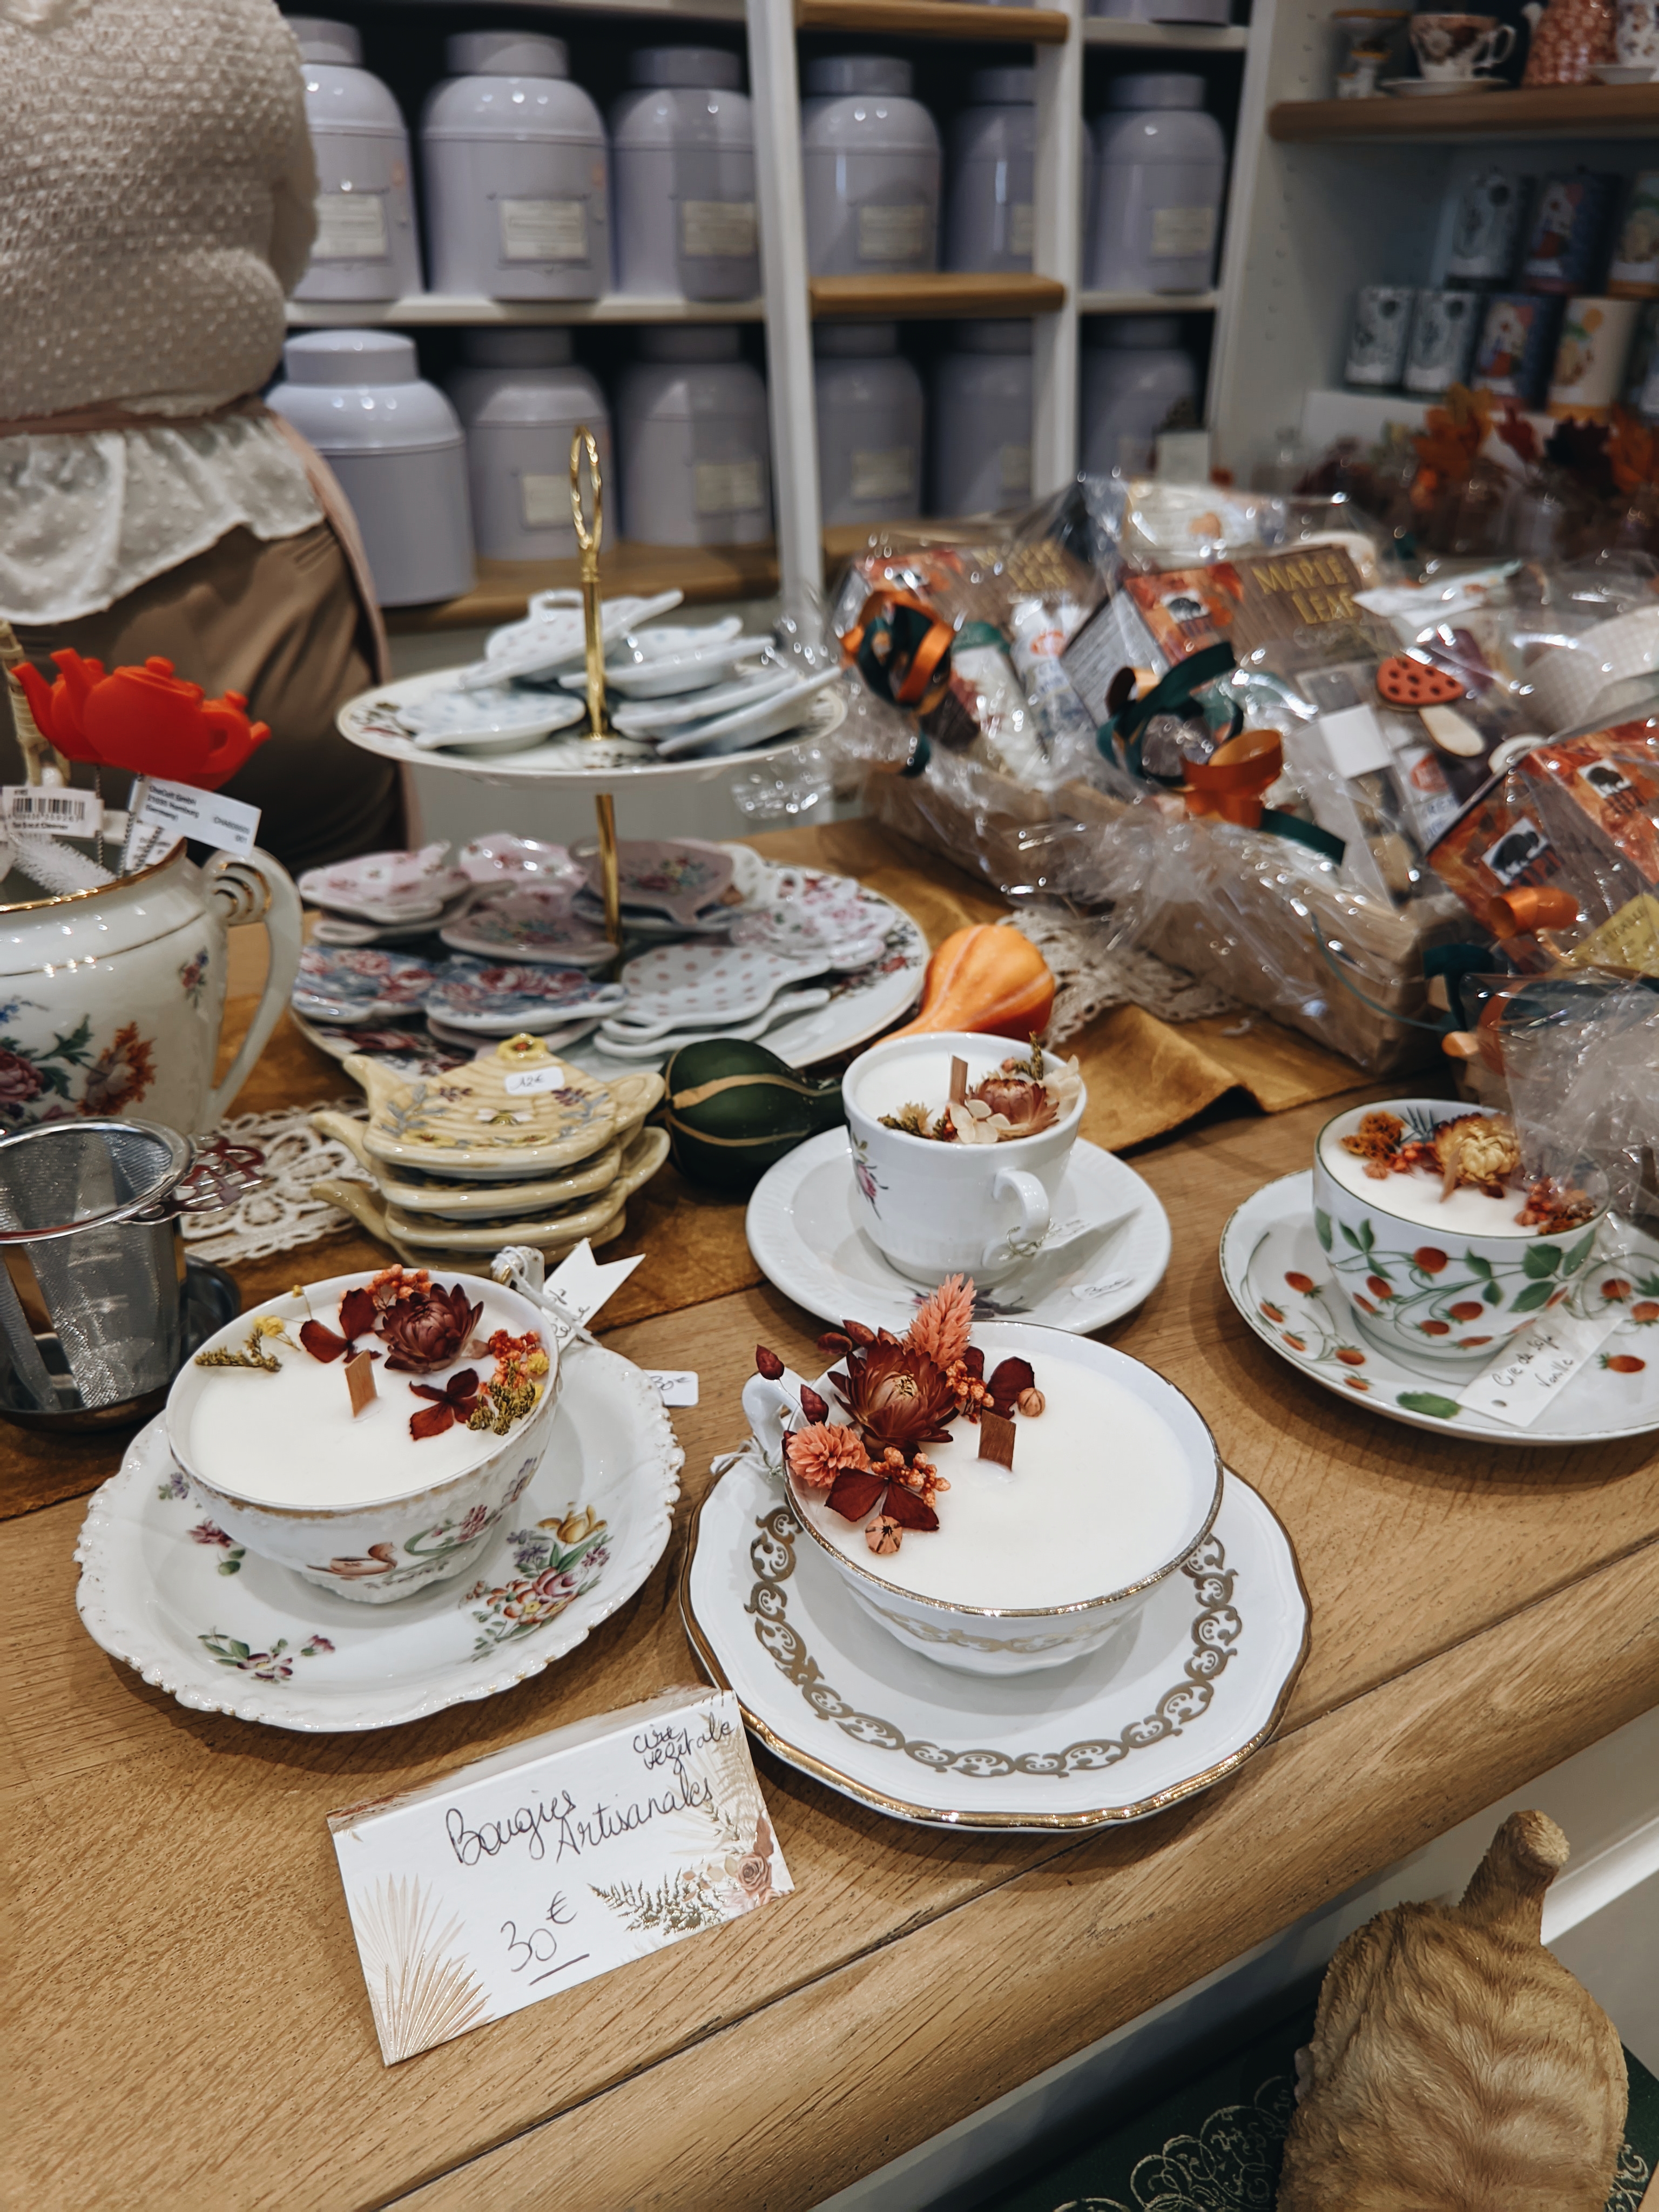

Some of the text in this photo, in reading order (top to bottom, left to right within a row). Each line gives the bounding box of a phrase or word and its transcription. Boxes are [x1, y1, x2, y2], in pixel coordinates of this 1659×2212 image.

[1251, 552, 1348, 595] MAPLE
[446, 1790, 577, 1866] Bougies
[555, 1773, 713, 1864] Artisanales
